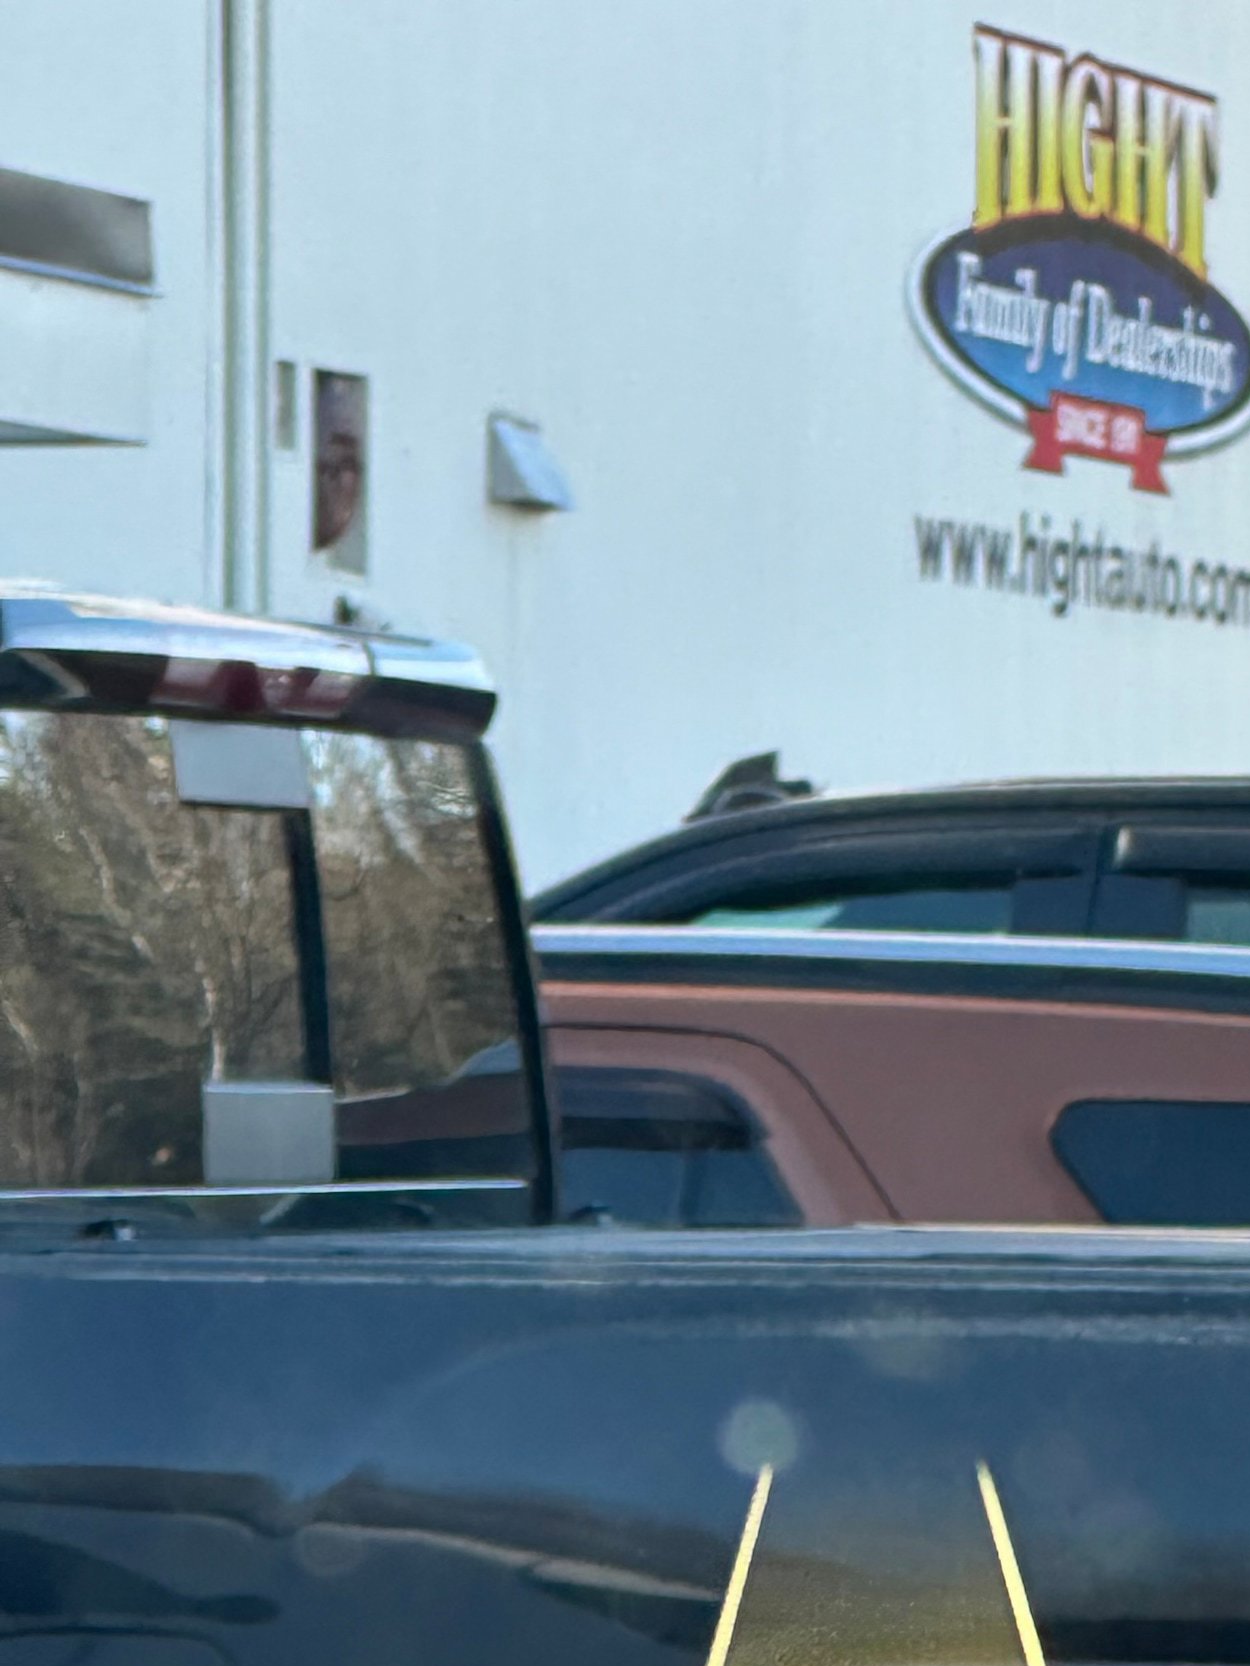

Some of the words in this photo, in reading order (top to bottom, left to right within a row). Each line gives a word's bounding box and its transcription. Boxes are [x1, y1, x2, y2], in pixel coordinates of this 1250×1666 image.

[973, 22, 1219, 280] HIGHT
[955, 250, 1050, 374] Family
[1052, 279, 1087, 381] of
[1085, 282, 1237, 411] Dealerships
